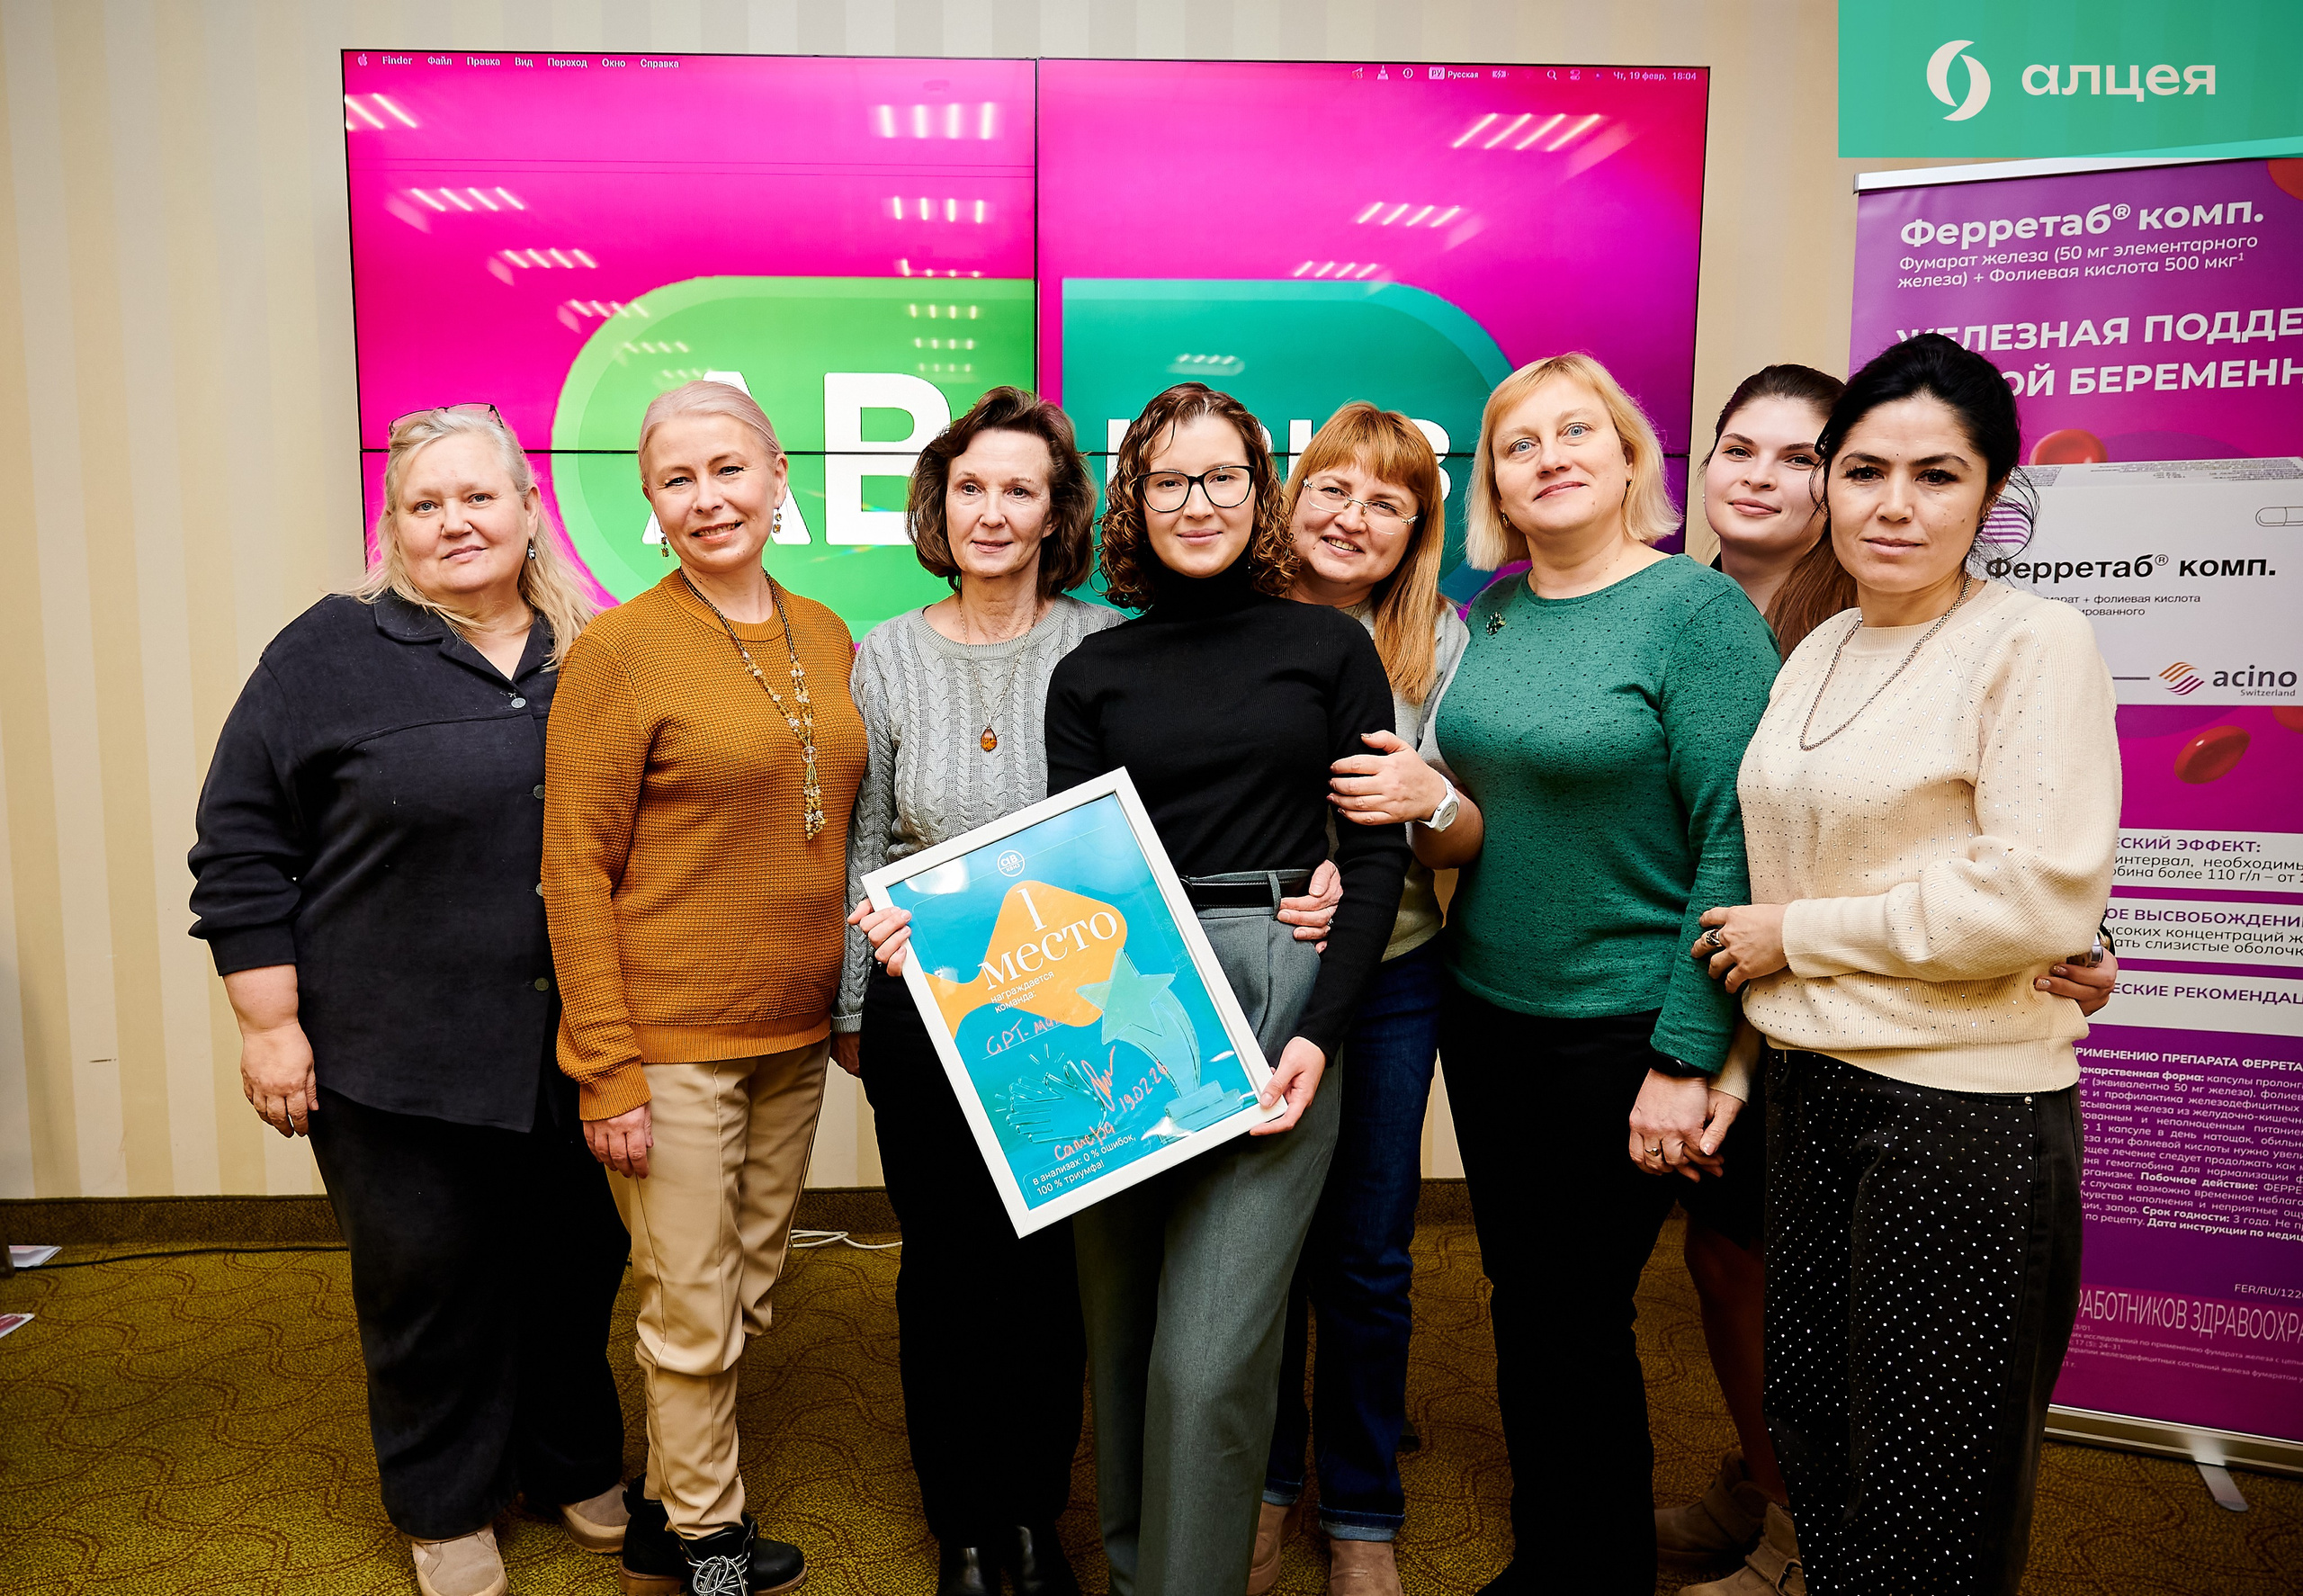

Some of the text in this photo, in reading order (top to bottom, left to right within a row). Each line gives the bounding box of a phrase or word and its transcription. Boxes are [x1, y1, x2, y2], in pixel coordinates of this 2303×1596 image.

[381, 55, 679, 69] Finder Файл Правка Вид Переход Окно Справка
[1447, 70, 1479, 79] Русская
[1672, 72, 1697, 80] 18:04
[2138, 201, 2264, 230] комп.
[1899, 236, 2258, 273] Фумарат железа (50 мг элементарного
[1897, 271, 1968, 288] железа)
[1989, 265, 2079, 282] Фолиевая
[2084, 260, 2159, 277] кислота
[2164, 256, 2200, 272] 500
[2143, 307, 2303, 346] ПОДДЕ
[2178, 559, 2277, 578] комп.
[2093, 595, 2151, 605] фолиевая
[2155, 595, 2200, 603] кислота
[2212, 665, 2298, 688] acino
[2240, 688, 2296, 697] Switzerland
[2176, 838, 2261, 853] ЭФФЕКТ:
[2115, 856, 2194, 868] интервал,
[2158, 866, 2202, 879] более
[2208, 868, 2236, 881] 110
[2239, 869, 2261, 882] г/л
[2278, 874, 2296, 883] от
[2135, 909, 2303, 928] ВЫСВОБОЖДЕНИ
[2115, 938, 2140, 948] ать
[2145, 940, 2229, 952] слизистые
[2166, 929, 2283, 943] концентраций
[977, 911, 1117, 991] место
[990, 971, 1055, 1004] награждается
[994, 991, 1037, 1014] команда:
[2074, 1047, 2159, 1062] РИМЕНЕНИЮ
[2162, 1053, 2239, 1068] ПРЕПАРАТА
[2092, 1077, 2170, 1091] (эквивалентно
[2173, 1083, 2188, 1092] 50
[2162, 1071, 2204, 1082] форма:
[2207, 1075, 2254, 1086] капсулы
[2255, 1079, 2303, 1089] пролонг
[2104, 1090, 2183, 1103] профилактика
[2188, 1097, 2300, 1112] железодефицитных
[2134, 1105, 2174, 1115] железа
[2177, 1107, 2190, 1116] из
[2156, 1117, 2245, 1131] неполноценным
[2095, 1123, 2101, 1132] 1
[2108, 1125, 2152, 1136] капсуле
[2170, 1129, 2197, 1139] день
[2261, 1136, 2303, 1148] обильн
[2104, 1136, 2124, 1144] или
[2128, 1137, 2181, 1149] фолиевой
[2184, 1143, 2229, 1153] кислоты
[2234, 1148, 2270, 1157] нужно
[1032, 1178, 1039, 1186] в
[1040, 1158, 1083, 1183] анализах:
[1083, 1152, 1090, 1161] 0
[1101, 1133, 1136, 1154] ошибок,
[2112, 1149, 2156, 1159] лечение
[2159, 1152, 2201, 1163] следует
[2205, 1156, 2272, 1169] продолжать
[2276, 1162, 2296, 1171] как
[1036, 1183, 1053, 1197] 100
[1064, 1159, 1105, 1185] триумфа!
[2106, 1159, 2174, 1171] гемоглобина
[2180, 1165, 2200, 1173] для
[2207, 1169, 2289, 1181] нормализации
[2090, 1180, 2132, 1190] случаях
[2136, 1184, 2191, 1196] возможно
[2194, 1189, 2254, 1201] временное
[2140, 1171, 2197, 1185] Побочное
[2201, 1179, 2258, 1190] действие:
[2128, 1195, 2193, 1207] наполнения
[2211, 1203, 2278, 1215] неприятные
[2101, 1215, 2146, 1226] рецепту.
[2146, 1217, 2177, 1229] Дата
[2179, 1223, 2247, 1235] инструкции
[2249, 1229, 2264, 1237] по
[2105, 1204, 2139, 1215] запор.
[2142, 1206, 2171, 1216] Срок
[2173, 1211, 2230, 1224] годности:
[2233, 1215, 2240, 1224] 3
[2244, 1217, 2272, 1226] года.
[2275, 1219, 2291, 1228] Не
[2235, 1284, 2303, 1298] FER/RU/122
